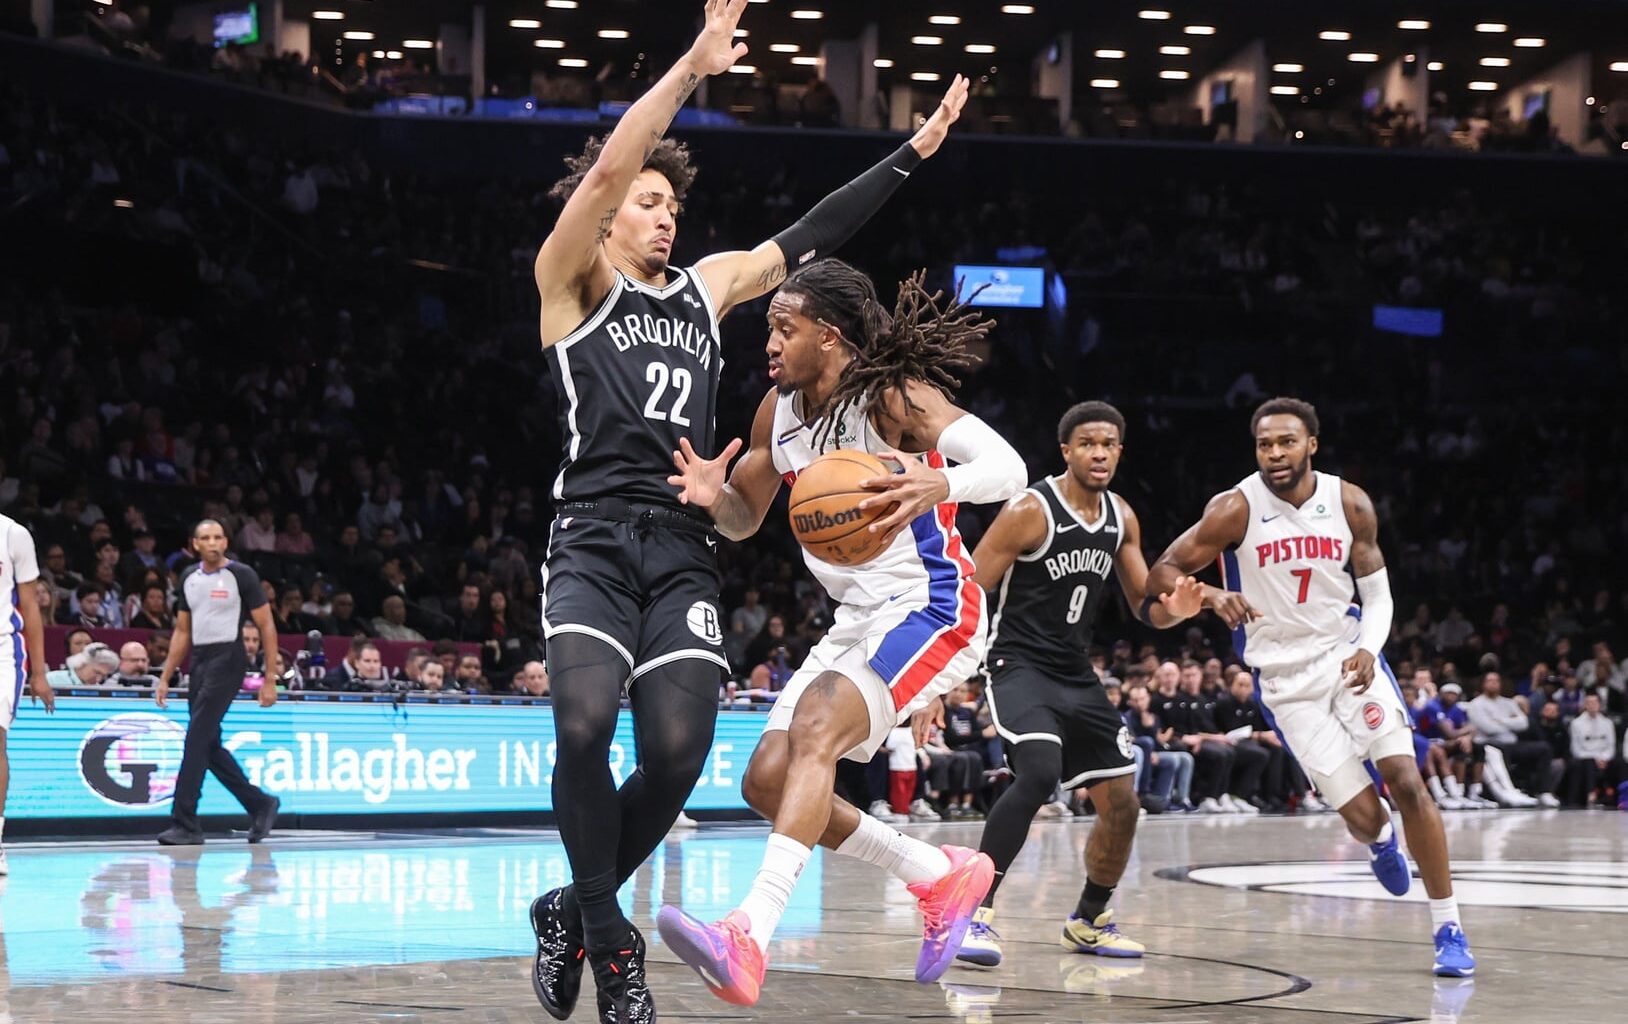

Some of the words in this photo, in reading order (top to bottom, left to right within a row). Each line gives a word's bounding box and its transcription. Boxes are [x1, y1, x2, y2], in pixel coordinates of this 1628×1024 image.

[606, 313, 712, 371] BROOKLYN
[643, 361, 693, 428] 22
[827, 435, 857, 445] StckX
[794, 507, 863, 533] Wilson
[1045, 548, 1113, 581] BROOKLYN
[1256, 535, 1343, 568] PISTONS
[1290, 568, 1312, 604] 7
[1066, 585, 1088, 624] 9
[223, 731, 477, 803] Gallagher
[499, 740, 734, 787] INSRE
